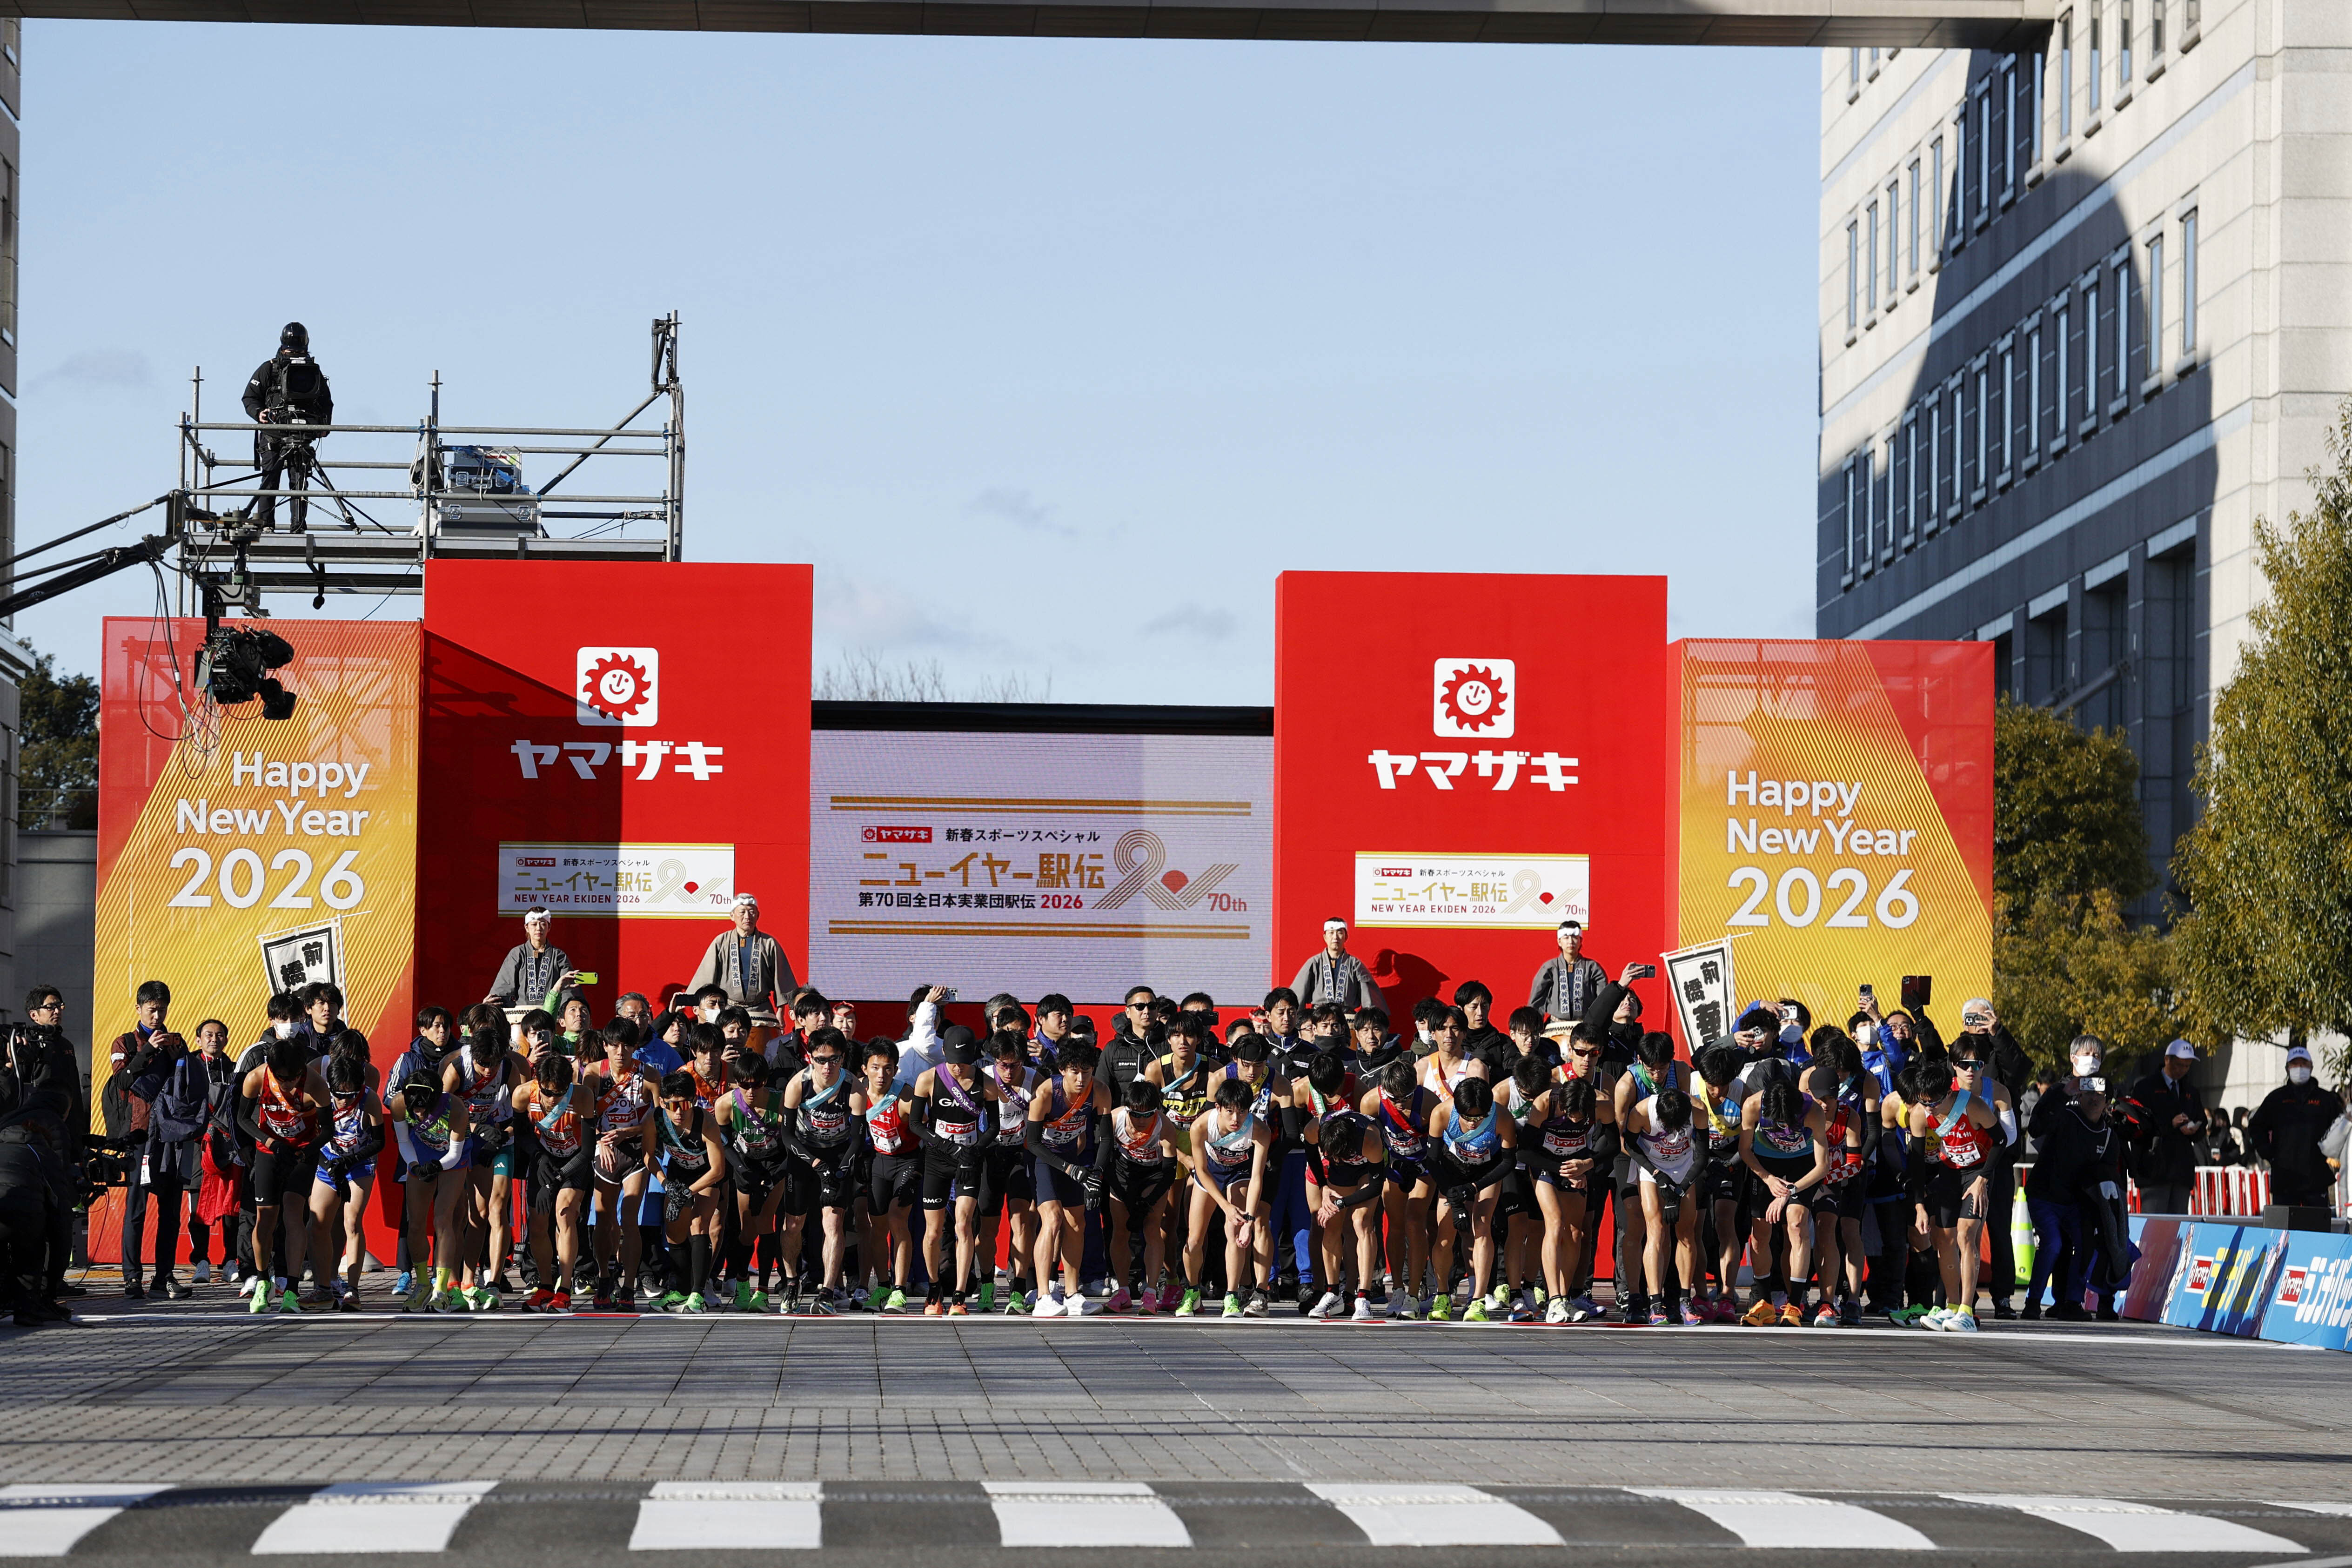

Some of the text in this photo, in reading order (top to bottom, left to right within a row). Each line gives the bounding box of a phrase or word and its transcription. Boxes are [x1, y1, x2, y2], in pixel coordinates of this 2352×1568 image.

[510, 739, 724, 781] ヤマザキ
[233, 751, 369, 798] Happy
[1368, 750, 1579, 792] ヤマザキ
[1728, 771, 1862, 817] Happy
[177, 798, 369, 837] New Year
[880, 828, 1100, 843] ヤマザキ 新春スポーツスペシャル
[1728, 818, 1916, 856] New Year
[563, 858, 650, 867] 新春スポーツスペシャル
[859, 852, 1106, 889] ニューイヤー駅伝
[168, 847, 364, 910] 2026
[515, 871, 652, 892] ニューイヤー駅伝
[515, 894, 640, 903] NEW YEAR EKIDEN 2026
[710, 894, 731, 905] 70th
[858, 891, 1083, 909] 第70回全日本実業団駅伝 2026
[1207, 893, 1247, 912] 70th
[1372, 882, 1508, 903] ニューイヤー駅伝
[1727, 867, 1920, 929] 2026
[1565, 905, 1587, 916] 70th
[938, 1098, 962, 1107] GM
[811, 1126, 840, 1136] 22-1
[873, 1134, 896, 1147] 7-1
[2295, 1256, 2352, 1328] ランチパッ
